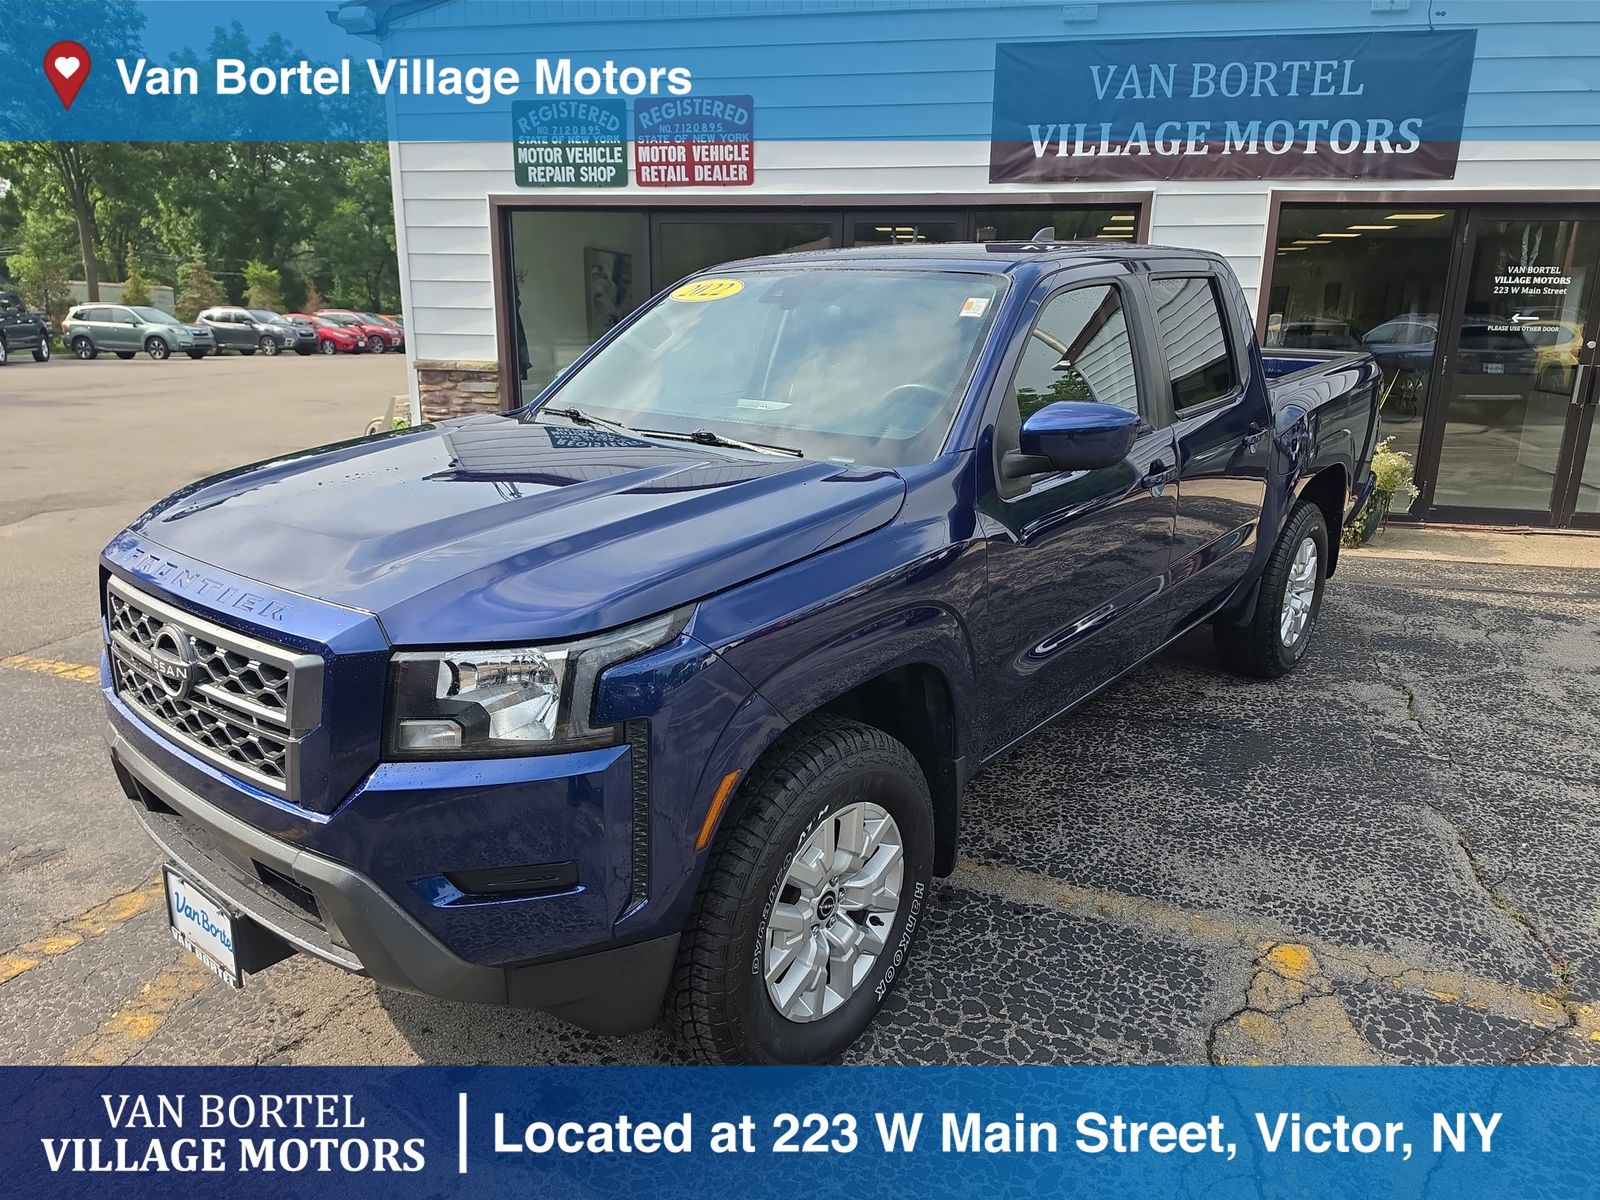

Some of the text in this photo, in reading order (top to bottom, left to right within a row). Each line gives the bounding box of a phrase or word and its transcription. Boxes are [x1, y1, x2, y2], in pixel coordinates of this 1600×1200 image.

[1089, 59, 1365, 100] VAN BORTEL
[517, 101, 620, 134] REGISTERED
[638, 98, 749, 130] REGISTERED
[551, 125, 601, 135] 7120895
[674, 122, 724, 133] 7120895
[518, 134, 621, 145] STATE OF NEW YORK
[637, 132, 750, 144] STATE OF NEW YORK
[1027, 117, 1424, 158] VILLAGE MOTORS
[518, 145, 623, 164] MOTOR VEHICLE
[638, 144, 750, 163] MOTOR VEHICLE
[527, 166, 617, 183] REPAIR SHOP
[641, 165, 748, 183] RETAIL DEALER
[1507, 266, 1562, 274] VAN BORTEL
[1494, 276, 1572, 285] VILLAGE MOTORS
[1521, 287, 1541, 295] Main
[1542, 287, 1568, 295] Street
[123, 547, 295, 623] FRONTIER
